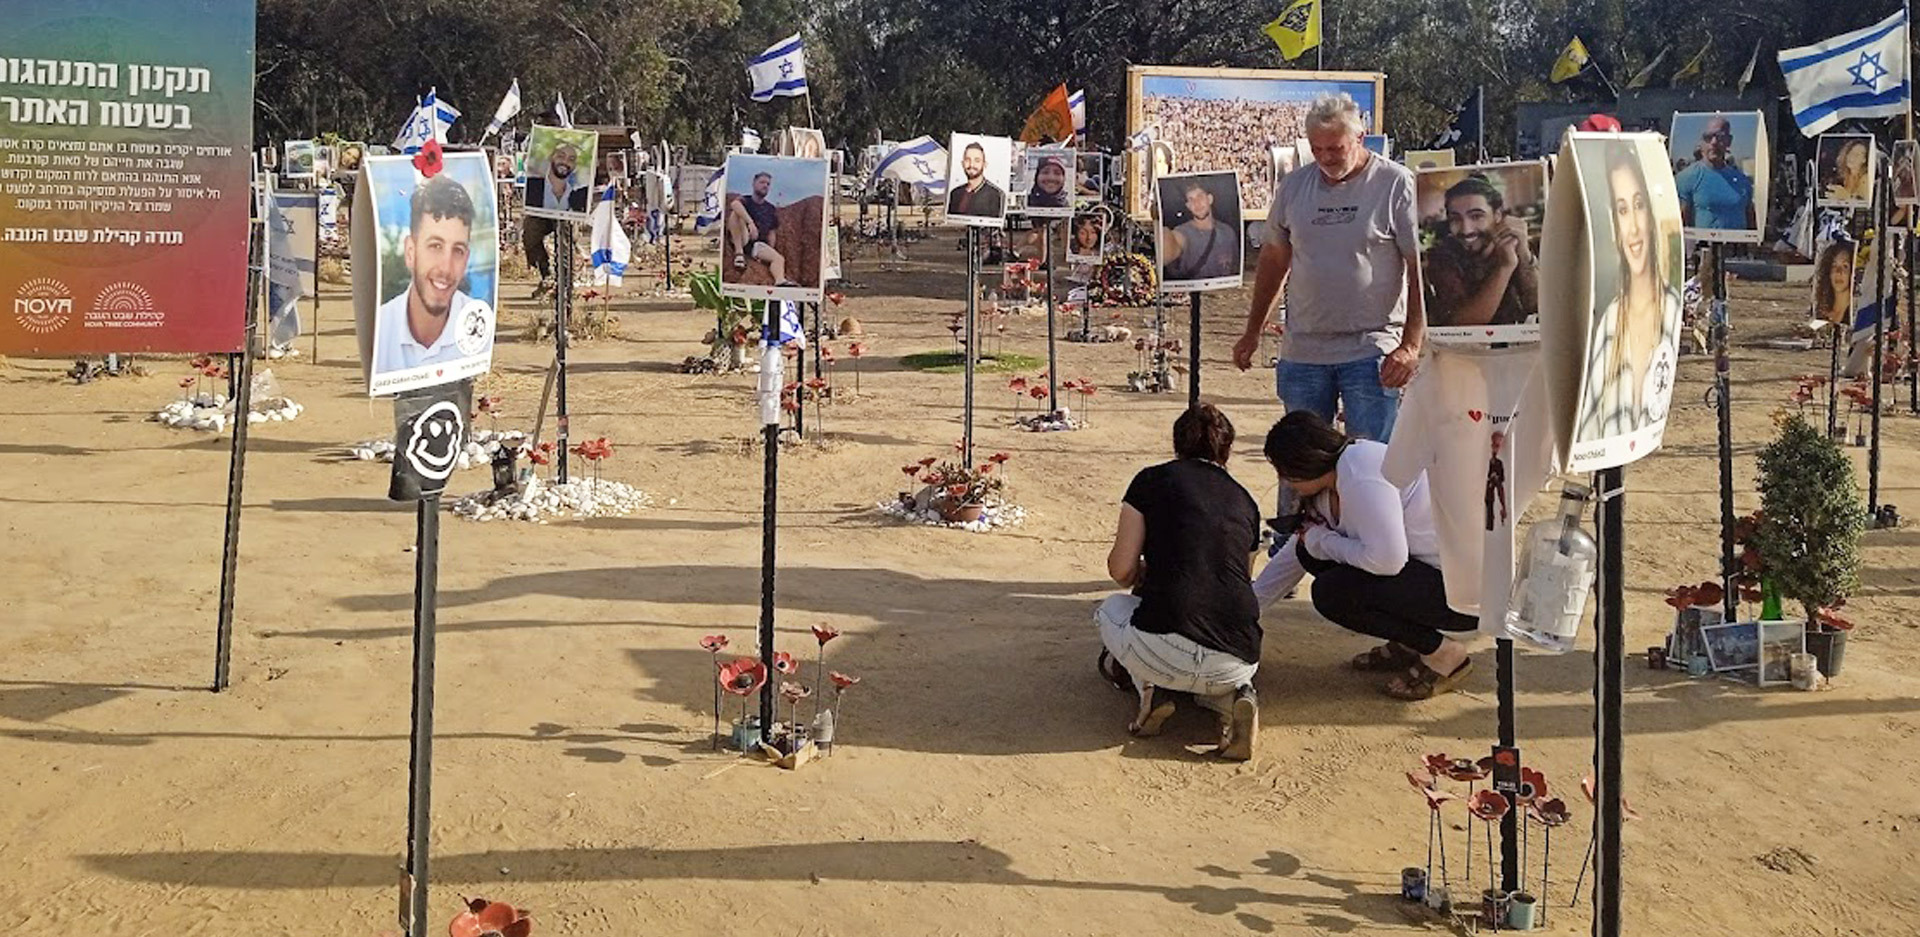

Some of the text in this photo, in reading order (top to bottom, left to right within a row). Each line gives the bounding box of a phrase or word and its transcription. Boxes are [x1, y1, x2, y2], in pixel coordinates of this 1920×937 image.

[0, 57, 210, 97] תקנון התנהגו
[0, 96, 192, 129] בשטח האתר
[22, 139, 44, 152] קרה
[48, 139, 85, 151] נמצאים
[89, 141, 113, 152] אתם
[117, 142, 128, 153] בו
[130, 143, 161, 154] בשטח
[165, 144, 192, 157] יקרים
[196, 146, 232, 156] אורחים
[5, 153, 184, 169] שגבה את חייהם של מאות קורבנות.
[36, 169, 70, 182] המקום
[74, 169, 99, 181] לרוח
[101, 171, 139, 182] בהתאם
[143, 172, 179, 183] התנהגו
[182, 174, 201, 184] אנא
[6, 182, 36, 194] למעט
[39, 184, 73, 195] במרחב
[77, 185, 116, 197] מוסיקה
[119, 185, 156, 197] הפעלת
[159, 185, 172, 198] על
[175, 188, 204, 198] איסור
[206, 187, 220, 199] חל
[55, 199, 87, 210] והסדר
[91, 200, 125, 213] הניקיון
[128, 200, 142, 212] על
[145, 201, 172, 212] שמרו
[0, 227, 183, 246] תודה קהילת שבט הנובה.
[15, 298, 72, 314] NOVA
[112, 311, 134, 320] שבט
[136, 311, 165, 320] קהילת
